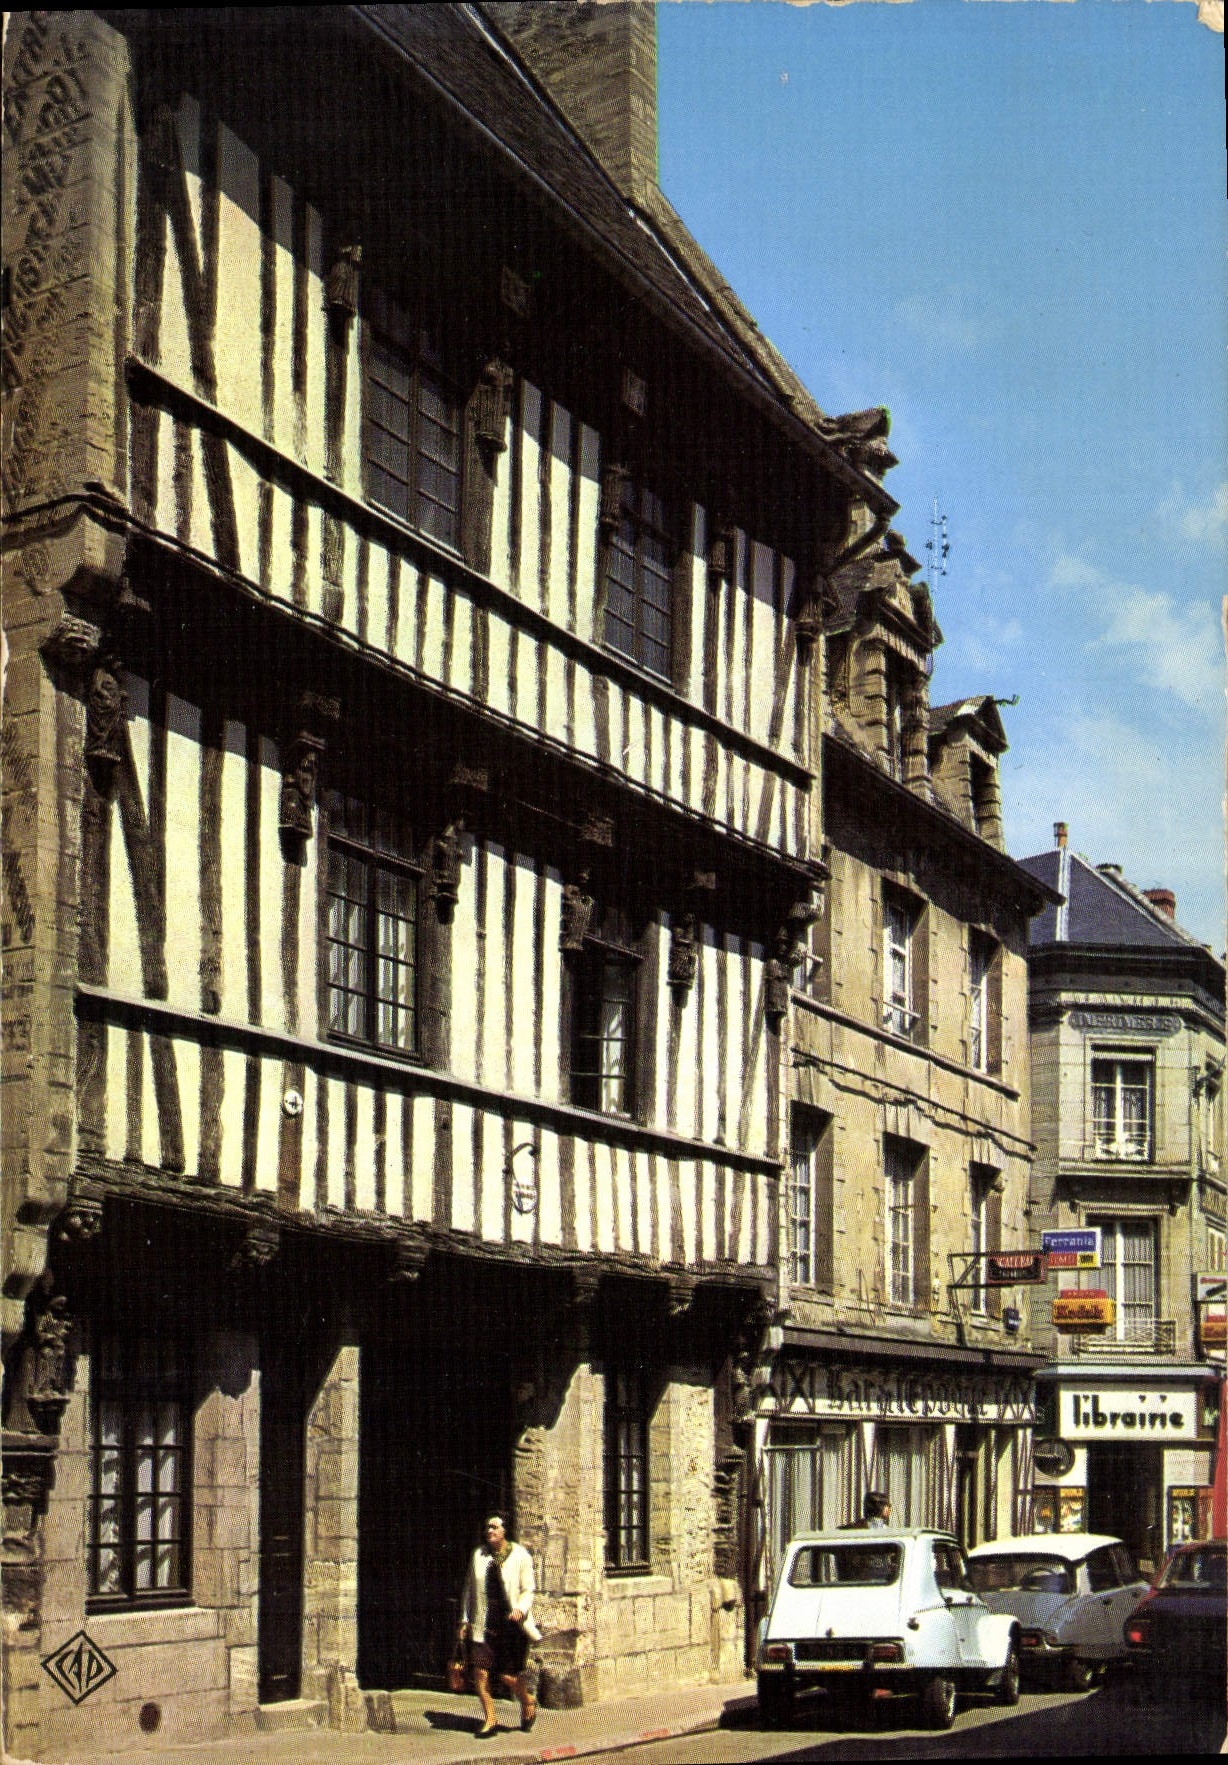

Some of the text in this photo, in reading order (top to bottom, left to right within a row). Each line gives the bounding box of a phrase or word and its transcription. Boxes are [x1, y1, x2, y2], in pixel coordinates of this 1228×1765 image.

[1044, 1235, 1095, 1247] Ferrania
[1055, 1304, 1104, 1319] Kodak
[1072, 1393, 1185, 1429] librairie
